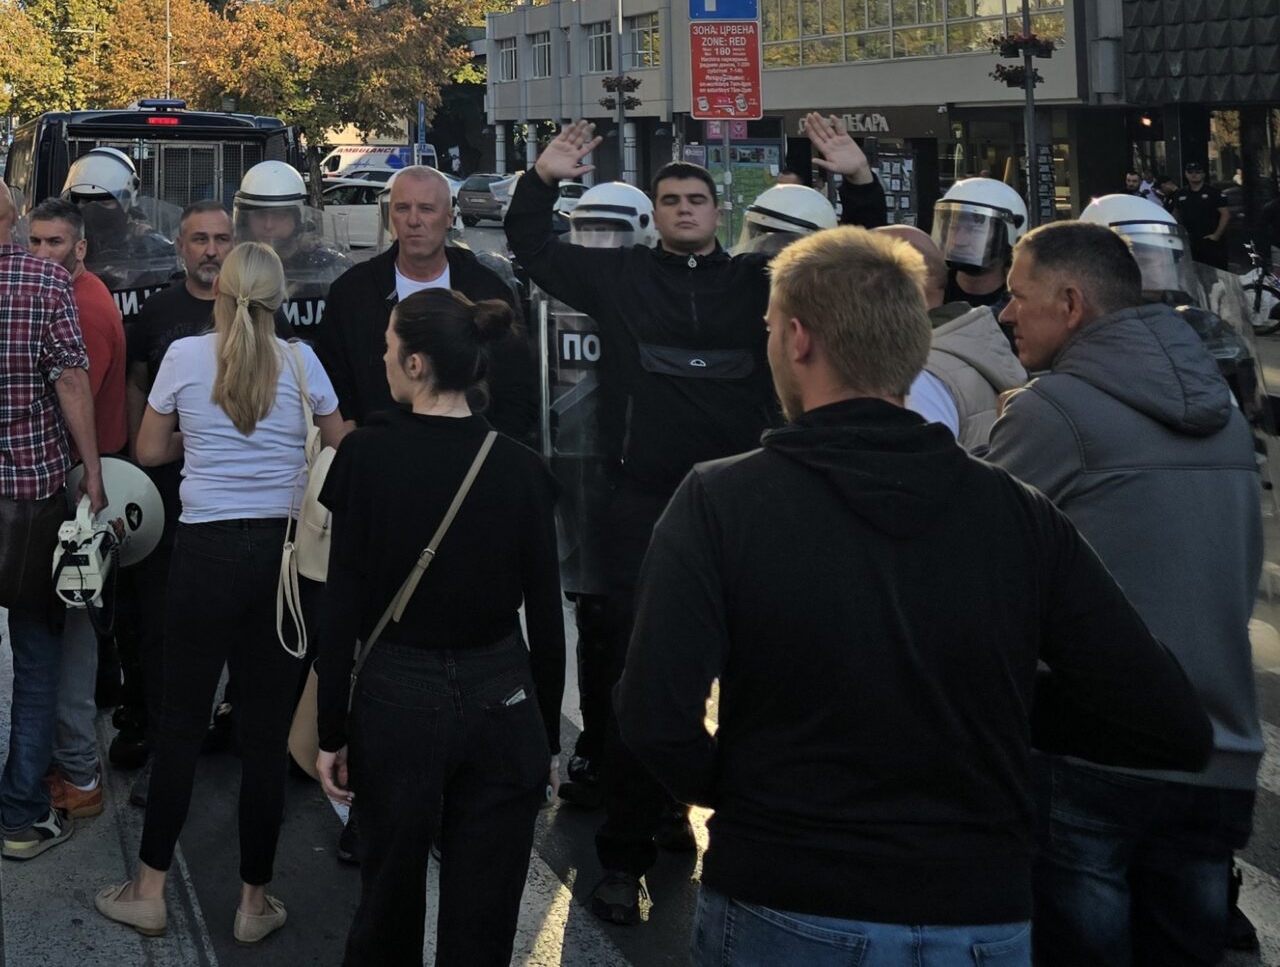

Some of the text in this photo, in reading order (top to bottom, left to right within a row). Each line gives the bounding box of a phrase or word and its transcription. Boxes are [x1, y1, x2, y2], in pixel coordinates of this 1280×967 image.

[720, 24, 754, 37] ЦРВЕНА
[701, 36, 747, 46] ZONE: RED
[714, 47, 731, 55] 180
[336, 146, 397, 154] AMBULANCE
[563, 333, 601, 362] ПО
